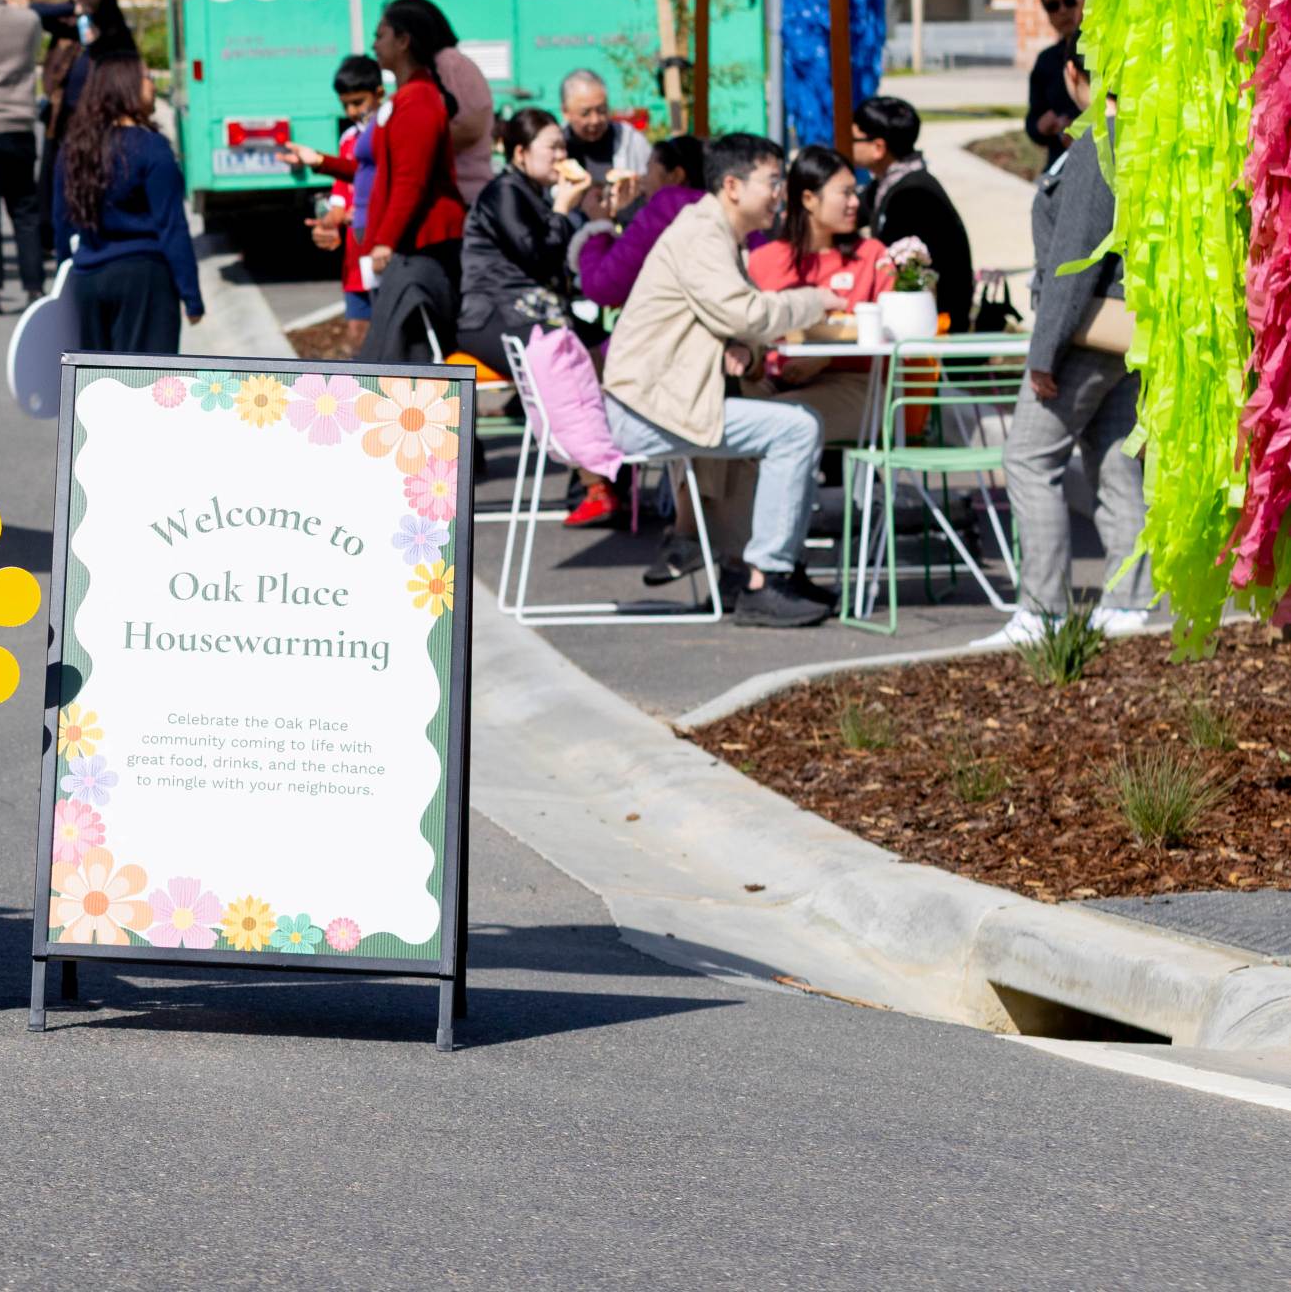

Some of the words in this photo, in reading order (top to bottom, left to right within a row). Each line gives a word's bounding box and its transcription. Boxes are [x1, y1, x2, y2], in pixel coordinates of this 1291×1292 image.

[148, 496, 322, 547] Welcome
[329, 525, 365, 556] to
[168, 570, 244, 602] Oak
[257, 572, 349, 607] Place
[123, 620, 391, 672] Housewarming
[167, 713, 239, 727] Celebrate
[245, 715, 269, 729] the
[274, 717, 303, 730] Oak
[309, 718, 349, 732] Place
[141, 733, 226, 749] community
[231, 737, 285, 752] coming
[291, 739, 306, 751] to
[311, 739, 334, 752] life
[339, 740, 372, 754] with
[126, 754, 165, 768] great
[170, 754, 207, 769] food,
[213, 755, 263, 771] drinks,
[268, 758, 296, 772] and
[302, 759, 325, 773] the
[331, 761, 385, 775] chance
[137, 775, 151, 786] to
[157, 775, 206, 790] mingle
[212, 777, 244, 790] with
[249, 781, 282, 793] your
[288, 780, 374, 796] neighbours.
